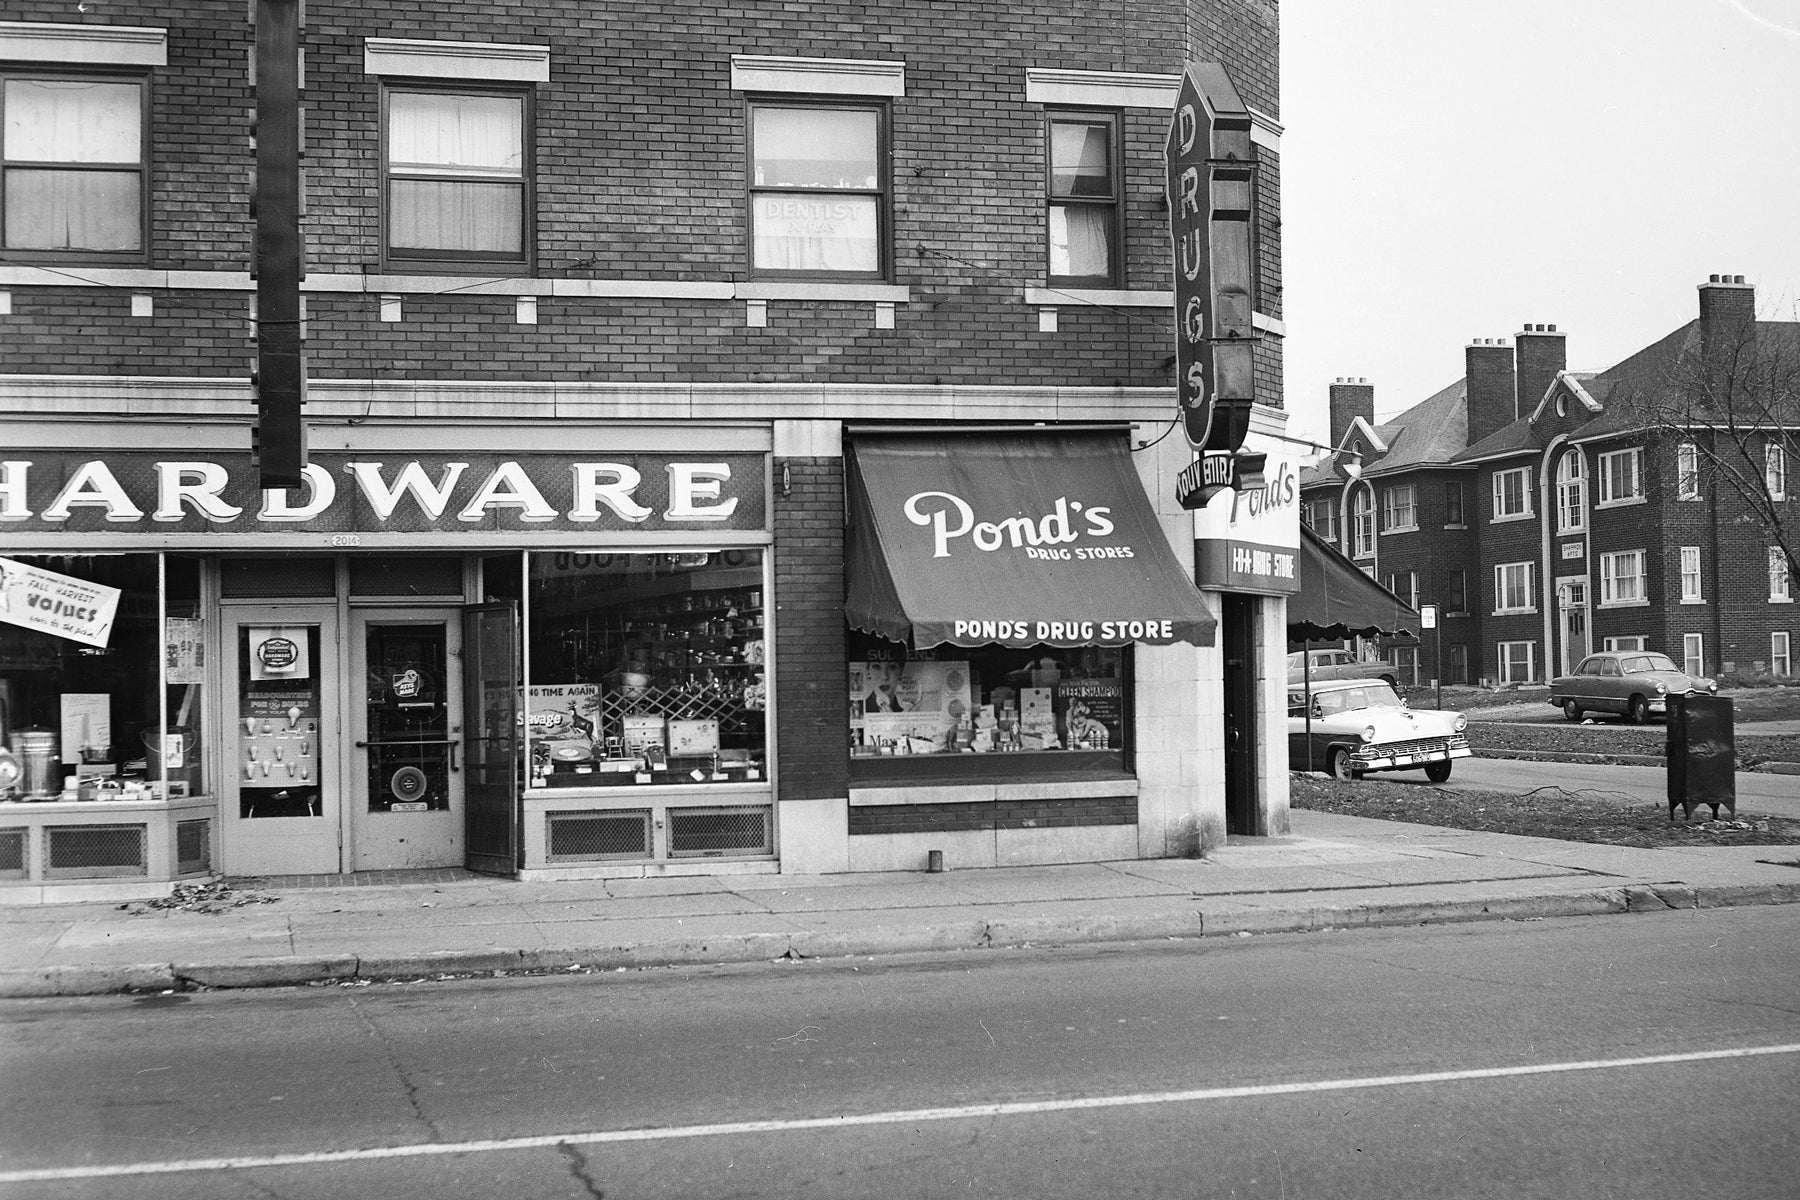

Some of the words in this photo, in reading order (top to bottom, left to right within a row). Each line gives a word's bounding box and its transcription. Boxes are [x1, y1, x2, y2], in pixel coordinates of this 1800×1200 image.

[766, 201, 860, 220] DENTIST
[1178, 103, 1205, 409] DRUGS
[1176, 456, 1236, 504] SOUVENIRS
[1229, 460, 1296, 527] Pond's
[903, 491, 1116, 558] Pond's
[1026, 546, 1072, 561] DRUG
[1074, 546, 1135, 560] STORES
[1252, 550, 1272, 576] DRUG
[1273, 553, 1295, 579] STORE
[27, 579, 49, 592] FALL
[55, 588, 95, 603] HARVEST
[954, 620, 1029, 640] POND'S
[1035, 620, 1094, 640] DRUG
[1101, 620, 1174, 640] STORE
[867, 649, 937, 661] SUENLY
[542, 687, 564, 697] TIME
[568, 686, 596, 697] AGAIN
[516, 710, 563, 728] Savage
